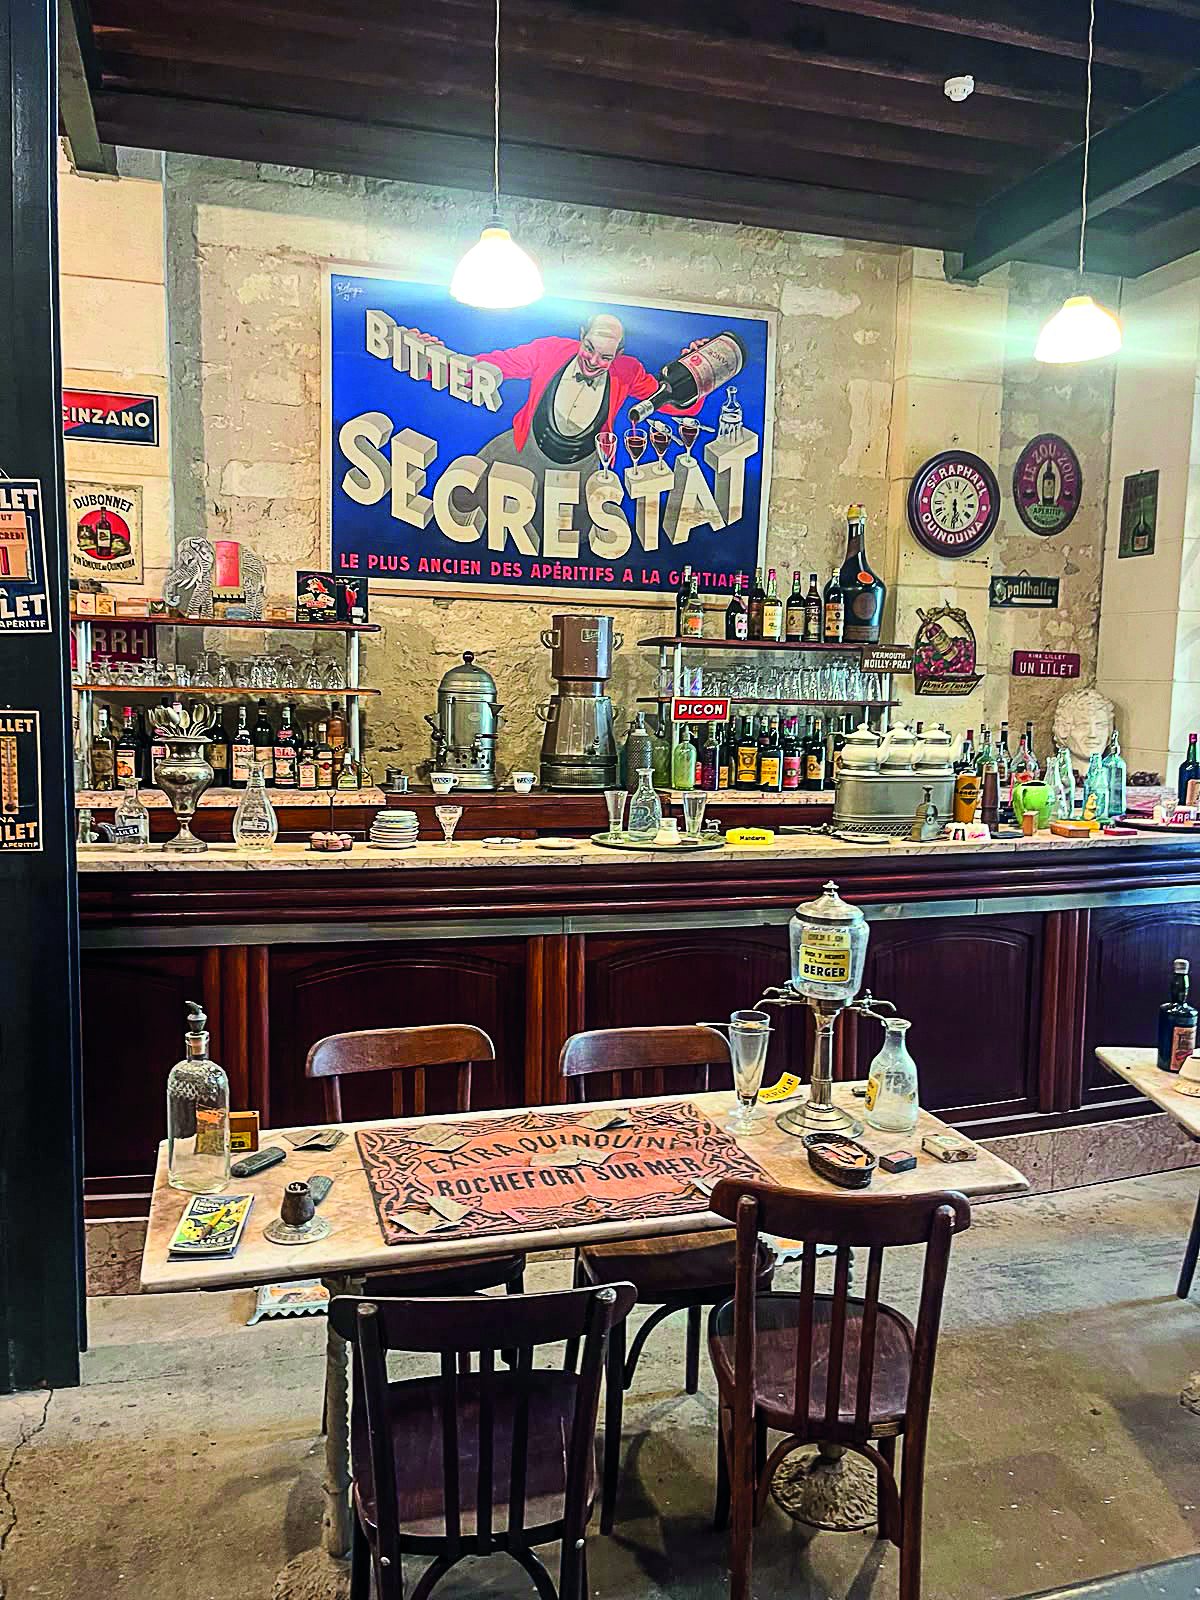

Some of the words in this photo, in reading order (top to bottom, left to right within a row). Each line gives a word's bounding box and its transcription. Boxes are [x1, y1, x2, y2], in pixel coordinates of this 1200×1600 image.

[366, 309, 504, 413] BITTER
[338, 411, 760, 560] SECRESTAT
[939, 464, 987, 497] RAPHAEL
[1023, 463, 1037, 482] LE
[73, 494, 134, 513] DUBONNET
[922, 512, 984, 544] QUINQUINA
[340, 553, 360, 570] LE
[368, 554, 411, 572] PLUS
[417, 557, 482, 576] ANCIEN
[490, 561, 524, 578] DES
[530, 561, 615, 583] APÉRITIFS
[622, 568, 634, 584] A
[642, 569, 662, 585] LA
[871, 651, 906, 660] VERMOUTH
[1020, 662, 1035, 675] UN
[1040, 663, 1074, 676] LILET
[678, 704, 723, 715] PICON
[803, 963, 846, 978] BERGER
[423, 1143, 520, 1174] EXTRA
[436, 1166, 586, 1197] ROCHEFORT
[594, 1162, 646, 1181] SUR
[642, 1156, 704, 1177] MER
